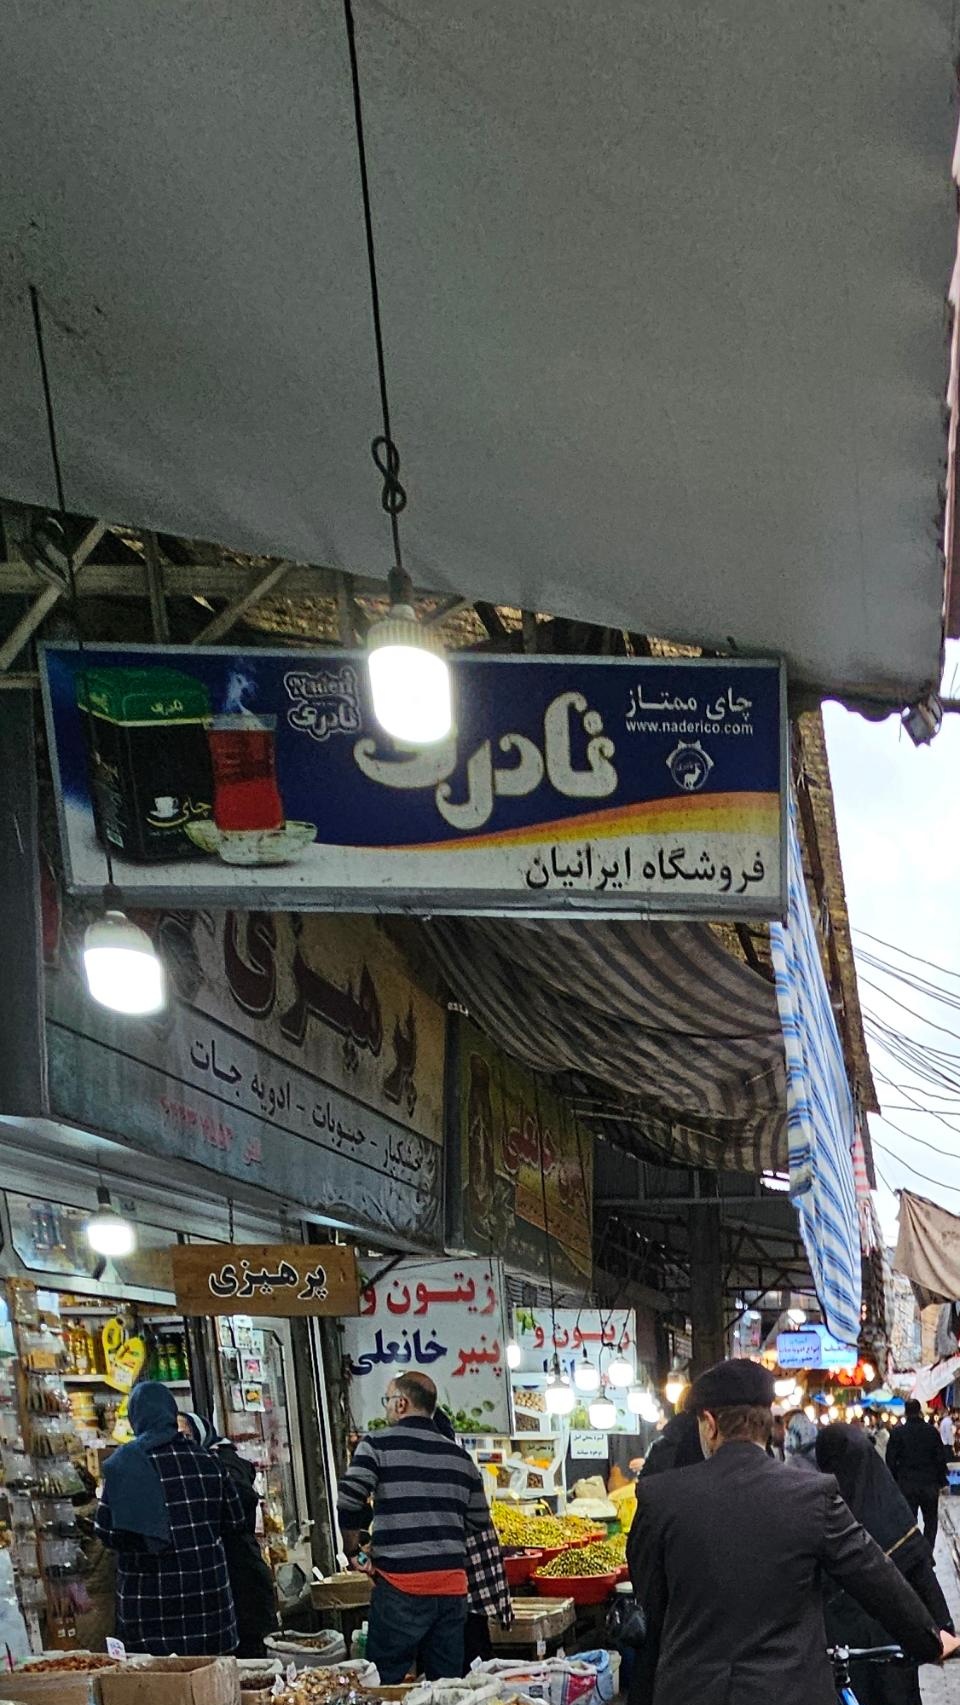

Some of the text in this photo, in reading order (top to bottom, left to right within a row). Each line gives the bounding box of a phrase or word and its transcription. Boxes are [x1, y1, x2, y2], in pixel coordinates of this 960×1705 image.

[625, 684, 753, 721] چای ممتاز
[625, 719, 754, 736] www.naderico.com
[525, 842, 766, 894] فروشگاه ایرانیان
[189, 1039, 243, 1098] جات
[250, 1073, 291, 1116] ادویه
[208, 1259, 328, 1300] پرهیزی
[360, 1271, 498, 1316] زیتون و
[349, 1326, 449, 1377] خانعلی
[451, 1334, 503, 1378] پنیر
